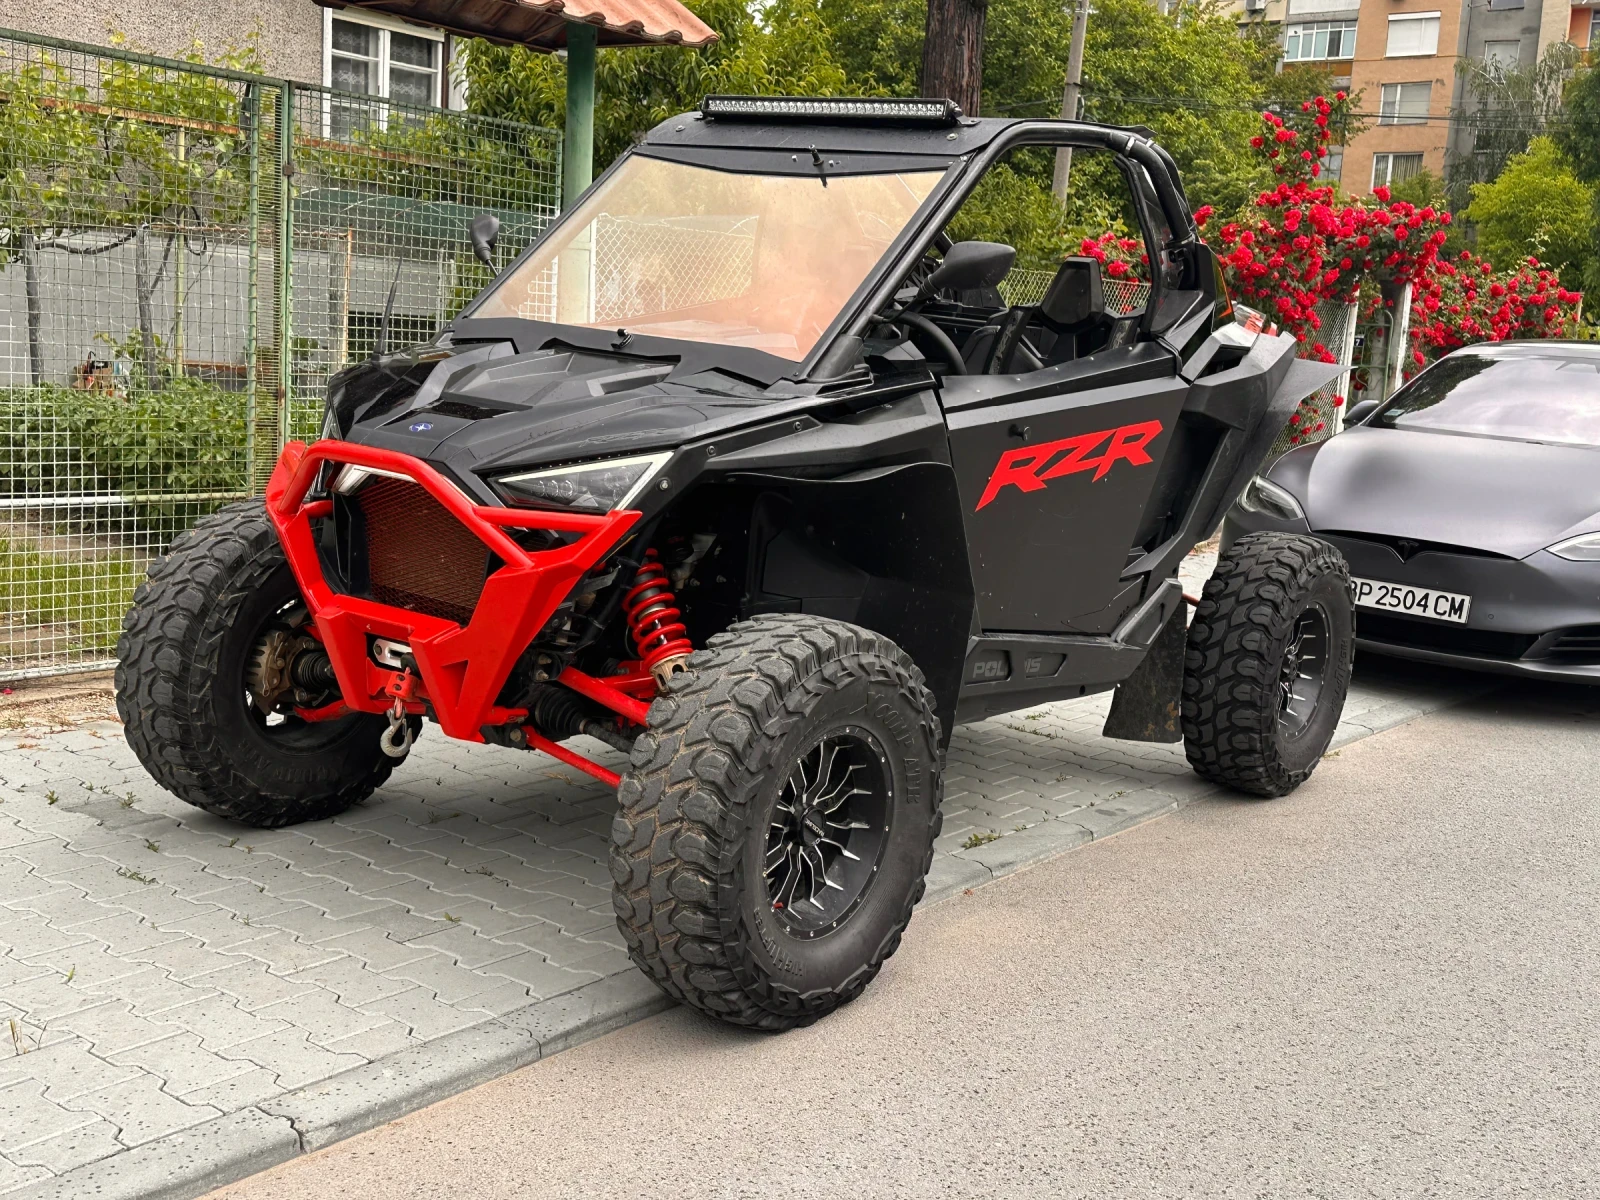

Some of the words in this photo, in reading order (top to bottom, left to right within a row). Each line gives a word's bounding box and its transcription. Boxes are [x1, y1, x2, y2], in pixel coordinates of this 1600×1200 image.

[974, 419, 1164, 513] RZR
[1375, 585, 1430, 613] 2504
[1433, 595, 1466, 619] CM
[972, 658, 1041, 678] POLIS
